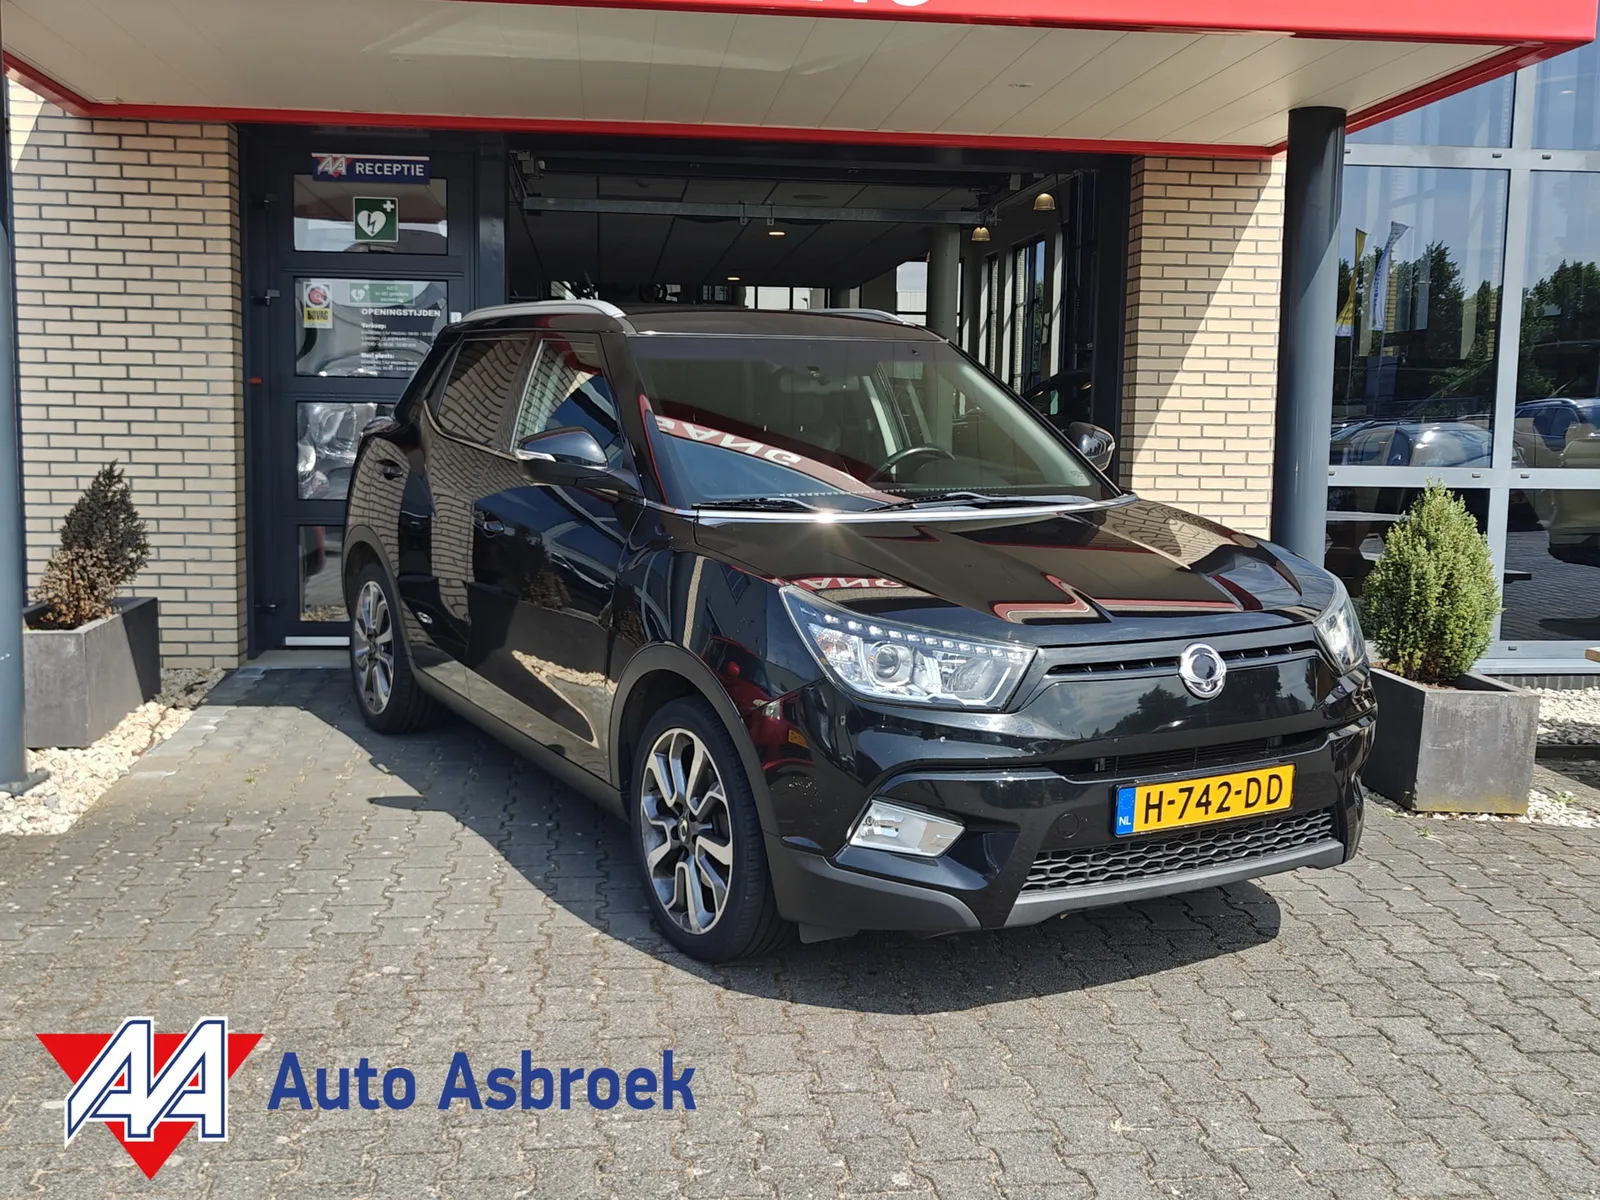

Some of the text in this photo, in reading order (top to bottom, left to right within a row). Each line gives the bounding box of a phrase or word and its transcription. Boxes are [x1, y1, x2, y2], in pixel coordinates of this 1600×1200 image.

[355, 162, 425, 176] RECEPTIE
[307, 310, 329, 320] BOVAG
[361, 308, 440, 317] OPENINGSTIJDEN
[1144, 774, 1283, 824] H-742-DD
[1119, 816, 1132, 827] NL
